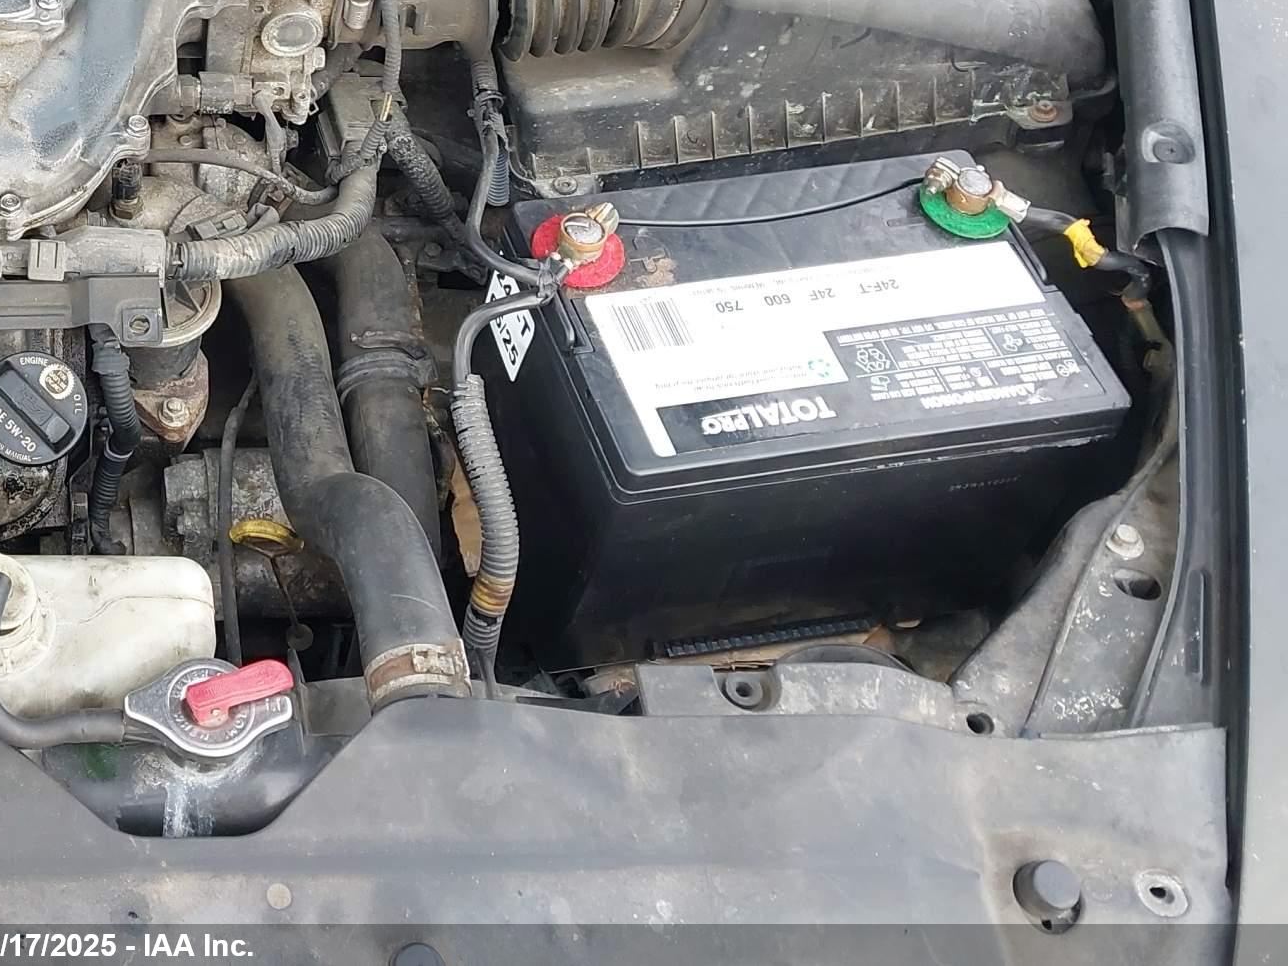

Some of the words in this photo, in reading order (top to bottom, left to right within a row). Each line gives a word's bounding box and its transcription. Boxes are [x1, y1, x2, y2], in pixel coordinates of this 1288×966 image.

[808, 287, 836, 302] 24F
[859, 279, 900, 295] 24F-T
[715, 299, 744, 314] 750
[764, 293, 792, 307] 600
[19, 356, 49, 367] ENGINE
[73, 394, 83, 415] OIL
[700, 395, 838, 436] TOTALPRO
[4, 419, 37, 452] 5W-20
[4, 447, 32, 462] MANUAL
